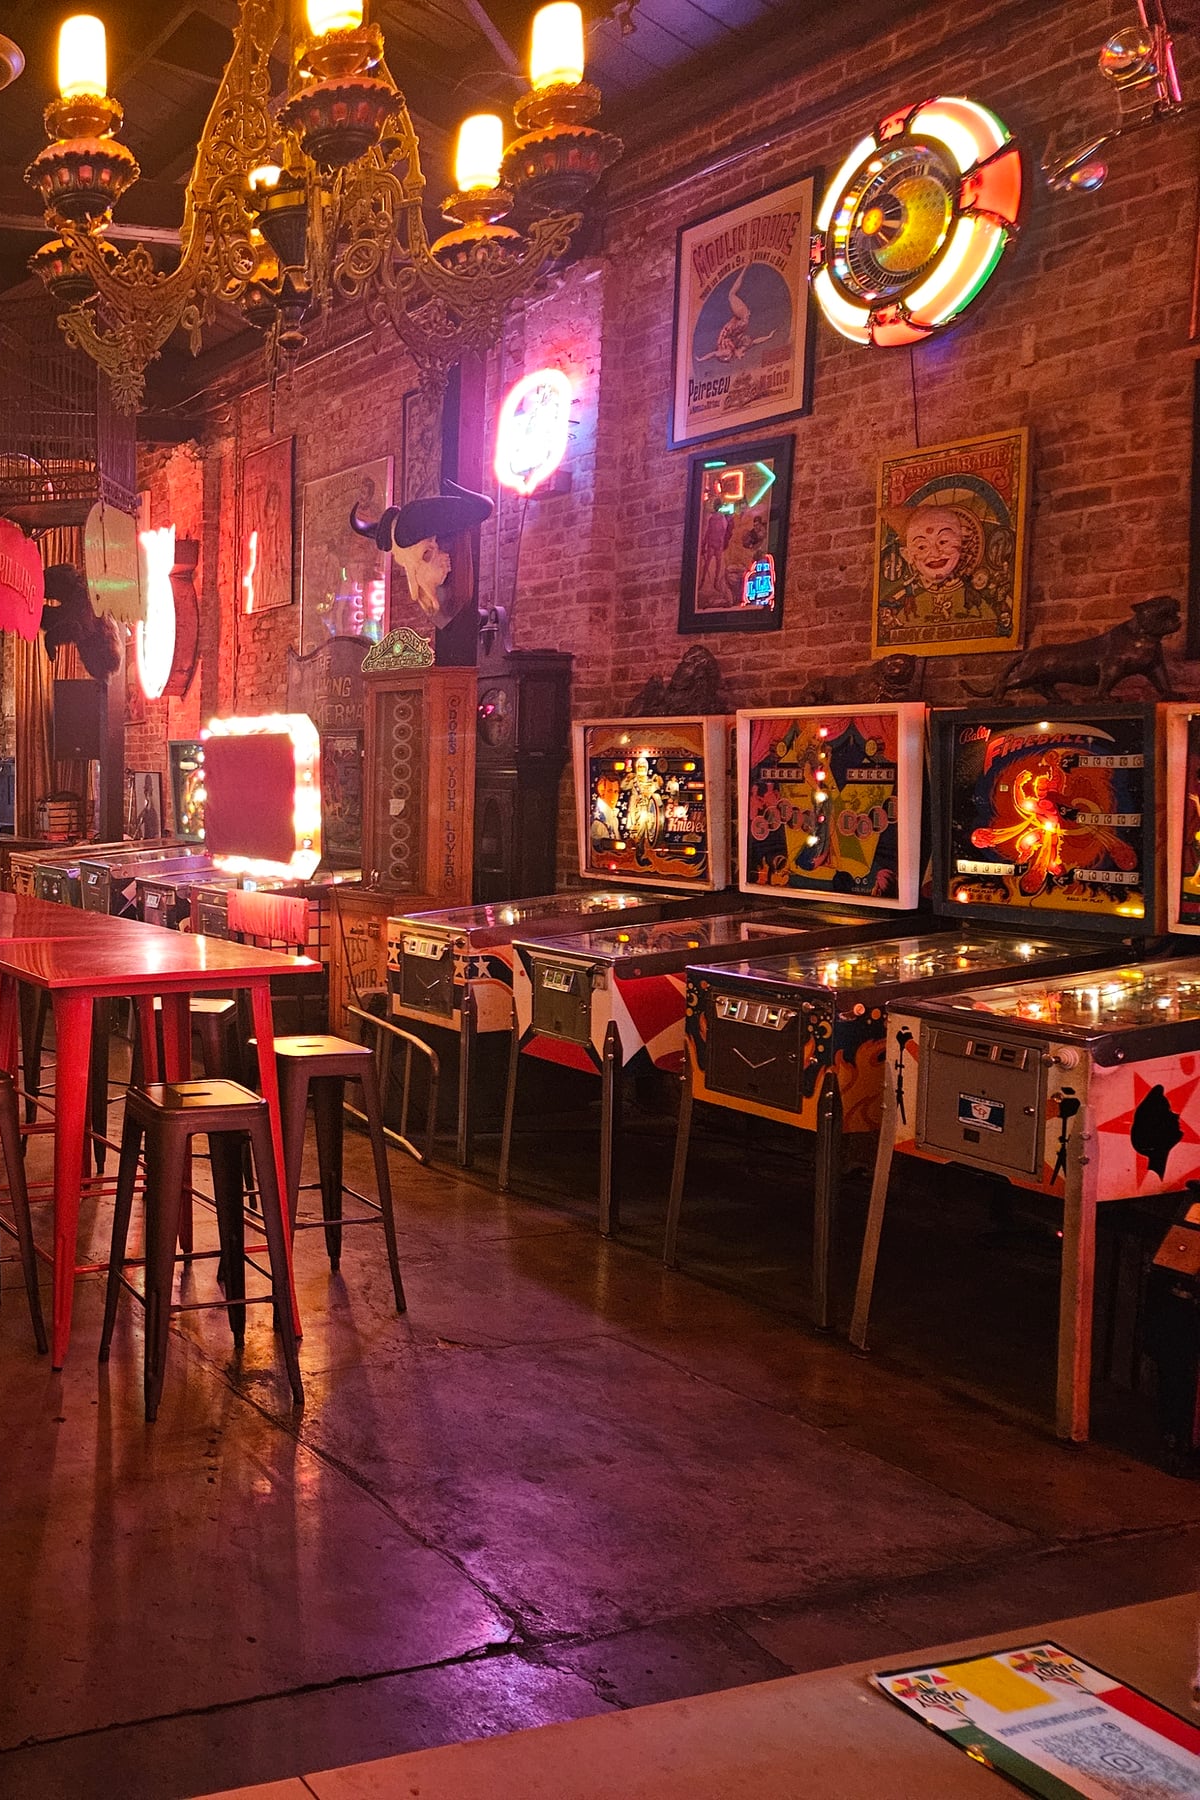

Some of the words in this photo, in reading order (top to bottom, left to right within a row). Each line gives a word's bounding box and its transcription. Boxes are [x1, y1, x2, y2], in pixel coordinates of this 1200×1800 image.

[692, 222, 748, 289] MOULIN
[749, 211, 801, 257] ROUGE
[314, 703, 364, 728] MERMA
[959, 725, 992, 745] Bally
[984, 733, 1085, 777] FIREBALL
[665, 803, 690, 818] Evel
[667, 818, 706, 833] Knievel
[1032, 1663, 1086, 1684] DADDY
[914, 1690, 970, 1709] DADDY
